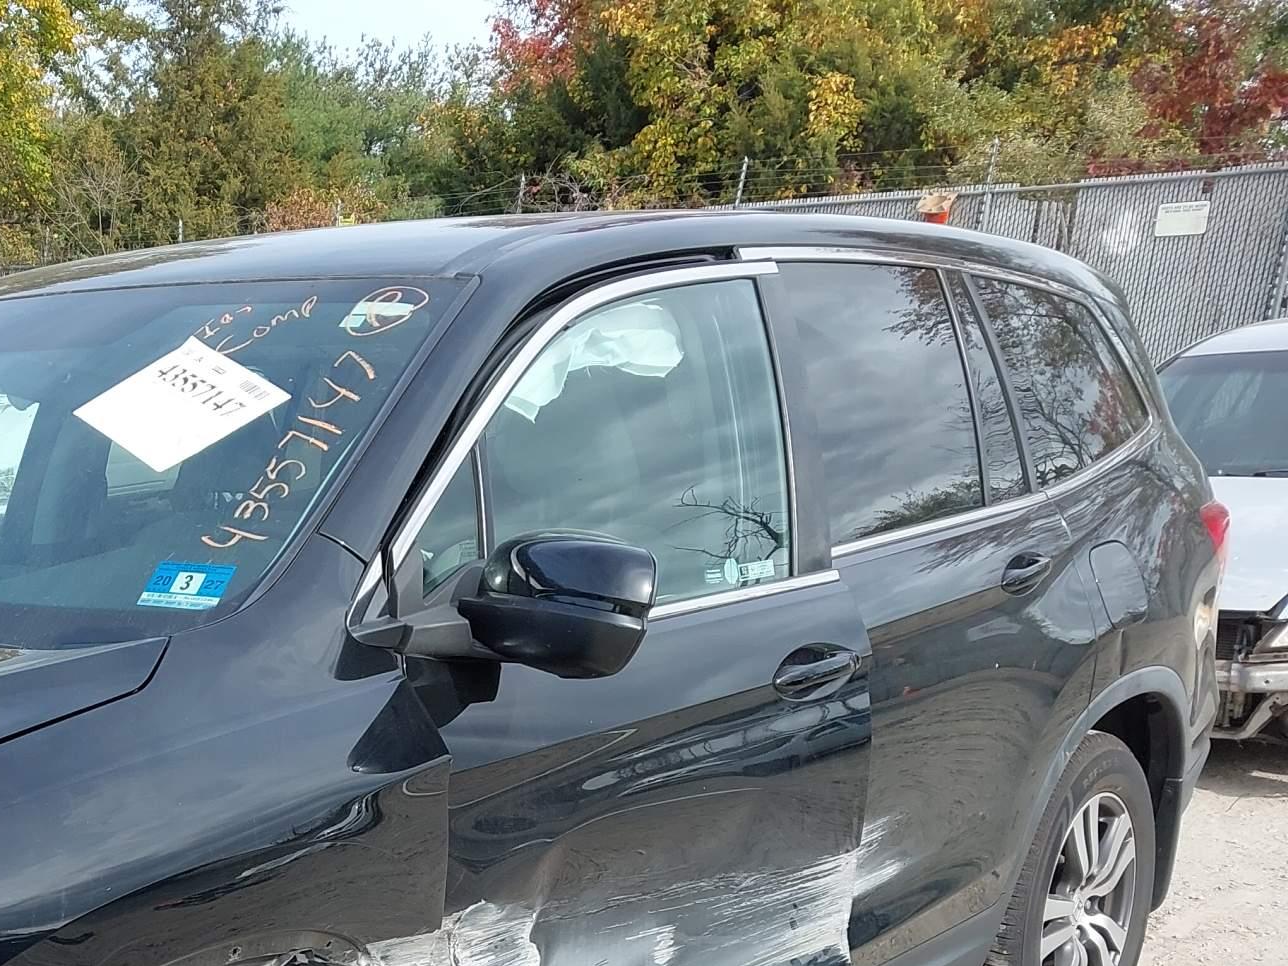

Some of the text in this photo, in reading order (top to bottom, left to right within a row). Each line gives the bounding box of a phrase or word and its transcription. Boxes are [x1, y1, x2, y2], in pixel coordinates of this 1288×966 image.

[157, 364, 247, 416] 43557147
[200, 350, 377, 548] 43557147
[153, 575, 173, 587] 20
[179, 574, 194, 590] 3
